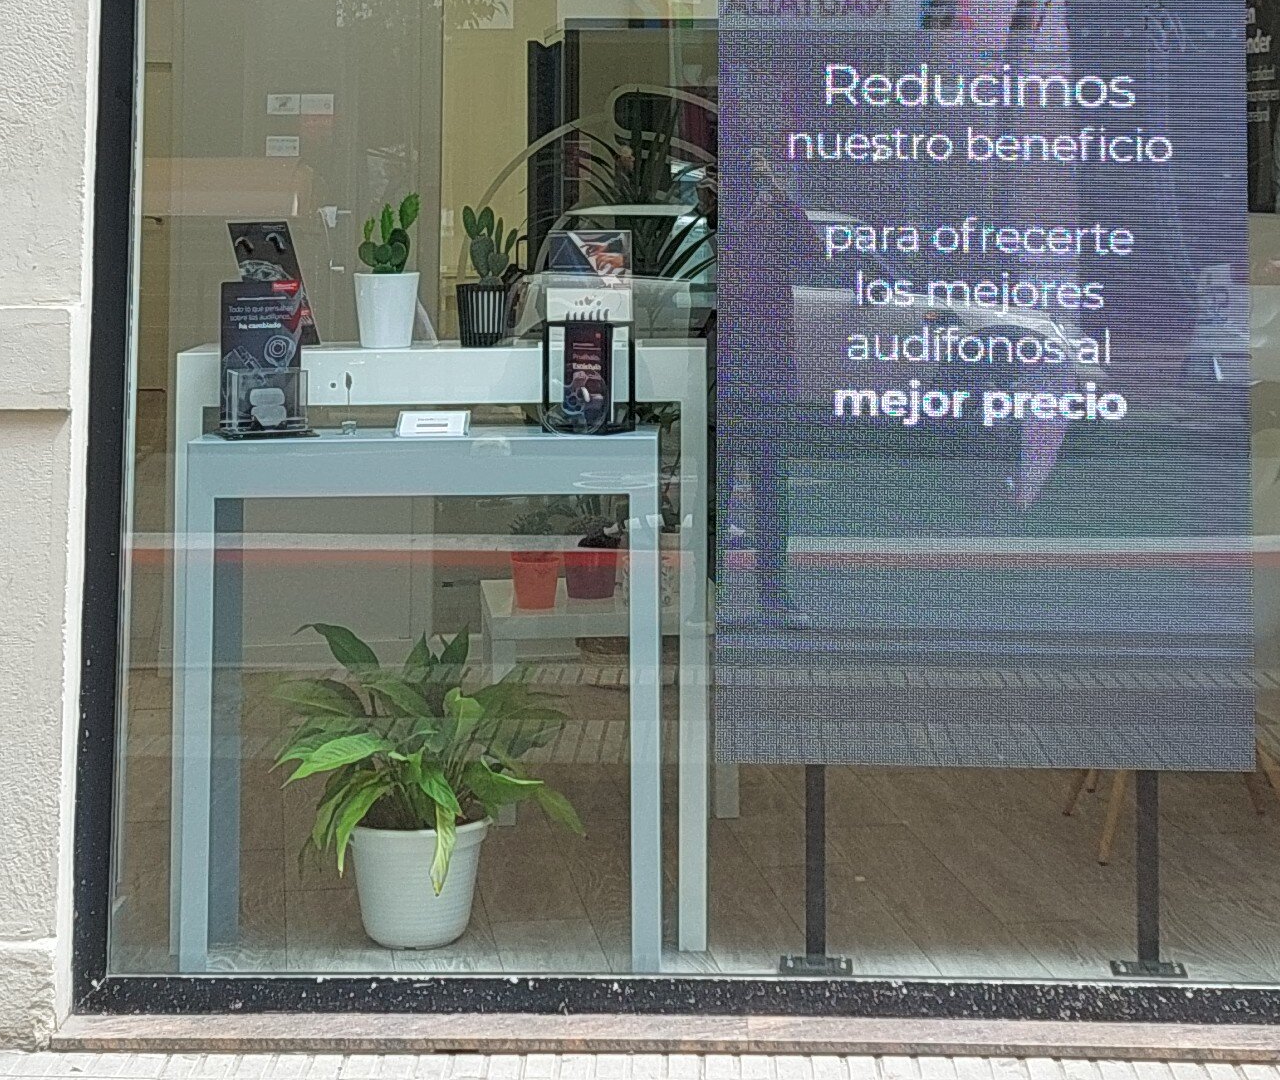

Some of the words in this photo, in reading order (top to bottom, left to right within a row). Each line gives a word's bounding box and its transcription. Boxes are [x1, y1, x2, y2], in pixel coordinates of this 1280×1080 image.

[823, 64, 1137, 110] Reducimos
[787, 129, 954, 163] nuestro
[966, 126, 1175, 163] beneficio
[824, 224, 920, 258] para
[931, 217, 1135, 255] ofrecerte
[855, 270, 915, 307] los
[926, 272, 1106, 310] mejores
[846, 326, 1065, 365] audífonos
[1076, 328, 1112, 365] al
[832, 379, 970, 425] mejor
[982, 381, 1128, 426] precio
